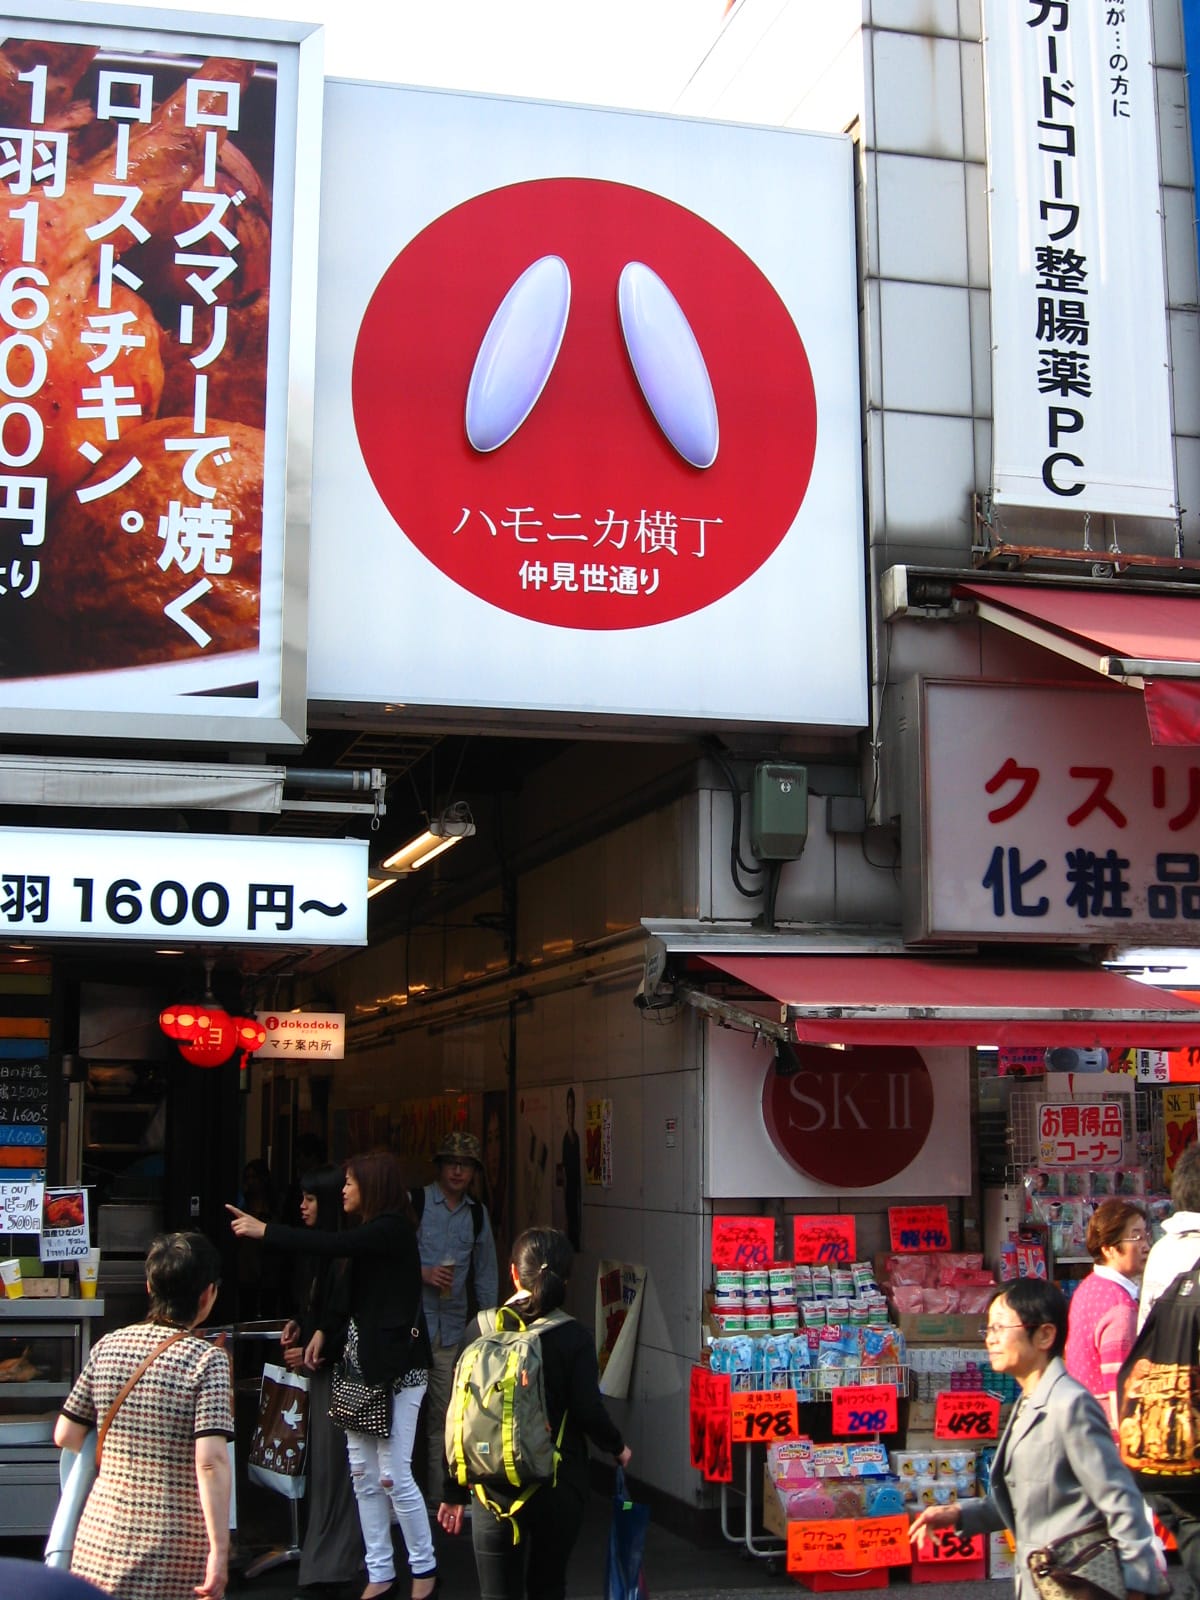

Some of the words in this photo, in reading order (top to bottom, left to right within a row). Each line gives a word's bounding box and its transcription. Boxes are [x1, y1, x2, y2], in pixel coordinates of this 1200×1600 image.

[1104, 0, 1130, 118] が…の方に
[75, 70, 154, 535] ローストチキン。
[157, 78, 246, 649] ローズマリーで焼く
[452, 506, 724, 558] ハモニカ横丁
[518, 560, 661, 596] 仲見世通り
[985, 758, 1200, 831] クスリ
[982, 846, 1200, 919] 化粧品
[280, 1020, 340, 1031] dokodoko
[270, 1040, 333, 1051] マチ案内所
[1042, 1106, 1122, 1138] お買得品
[1057, 1141, 1119, 1162] コーナー
[11, 1185, 29, 1195] OUT
[744, 1410, 793, 1438] 198
[847, 1410, 888, 1432] 298
[947, 1411, 993, 1434] 498
